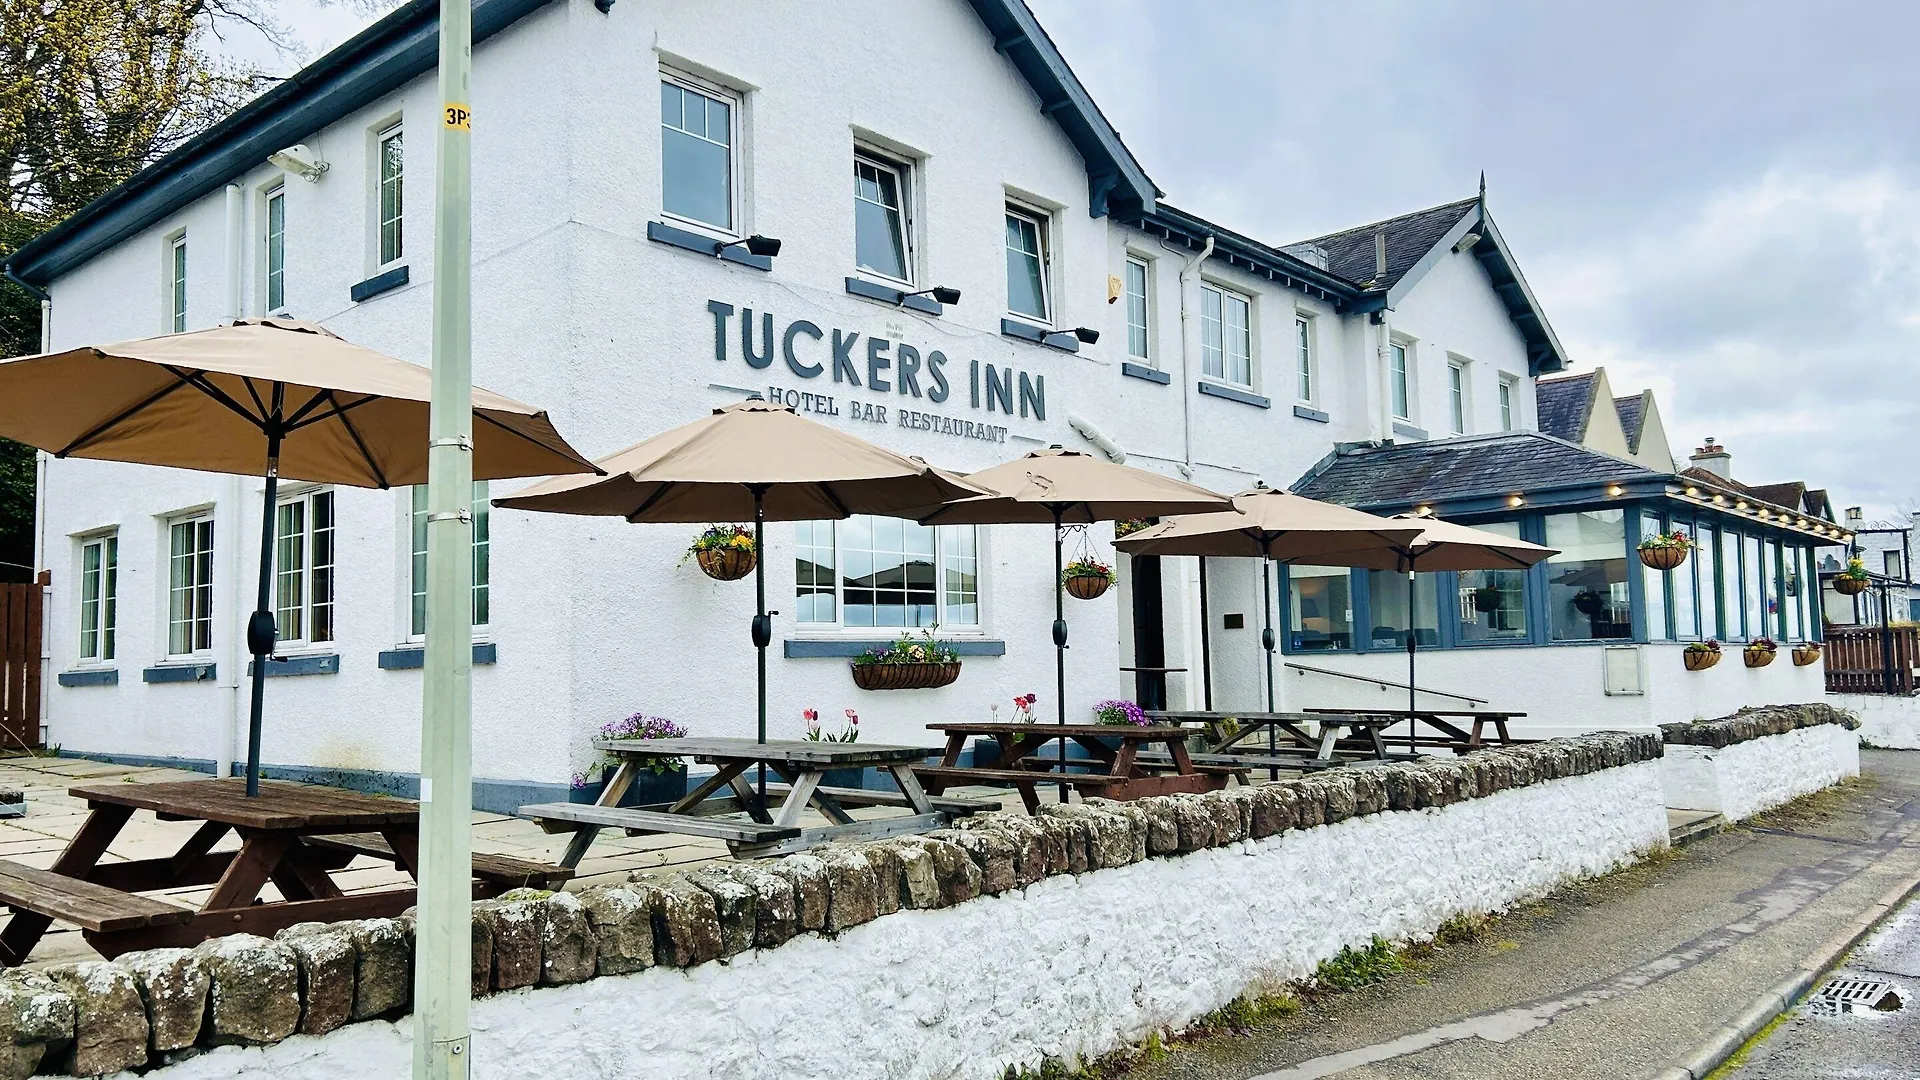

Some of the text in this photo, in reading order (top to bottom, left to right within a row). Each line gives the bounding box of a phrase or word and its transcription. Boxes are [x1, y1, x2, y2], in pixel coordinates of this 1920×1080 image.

[707, 300, 1046, 421] TUCKERS INN
[768, 386, 1008, 444] HOTEL BAR RESTAURANT
